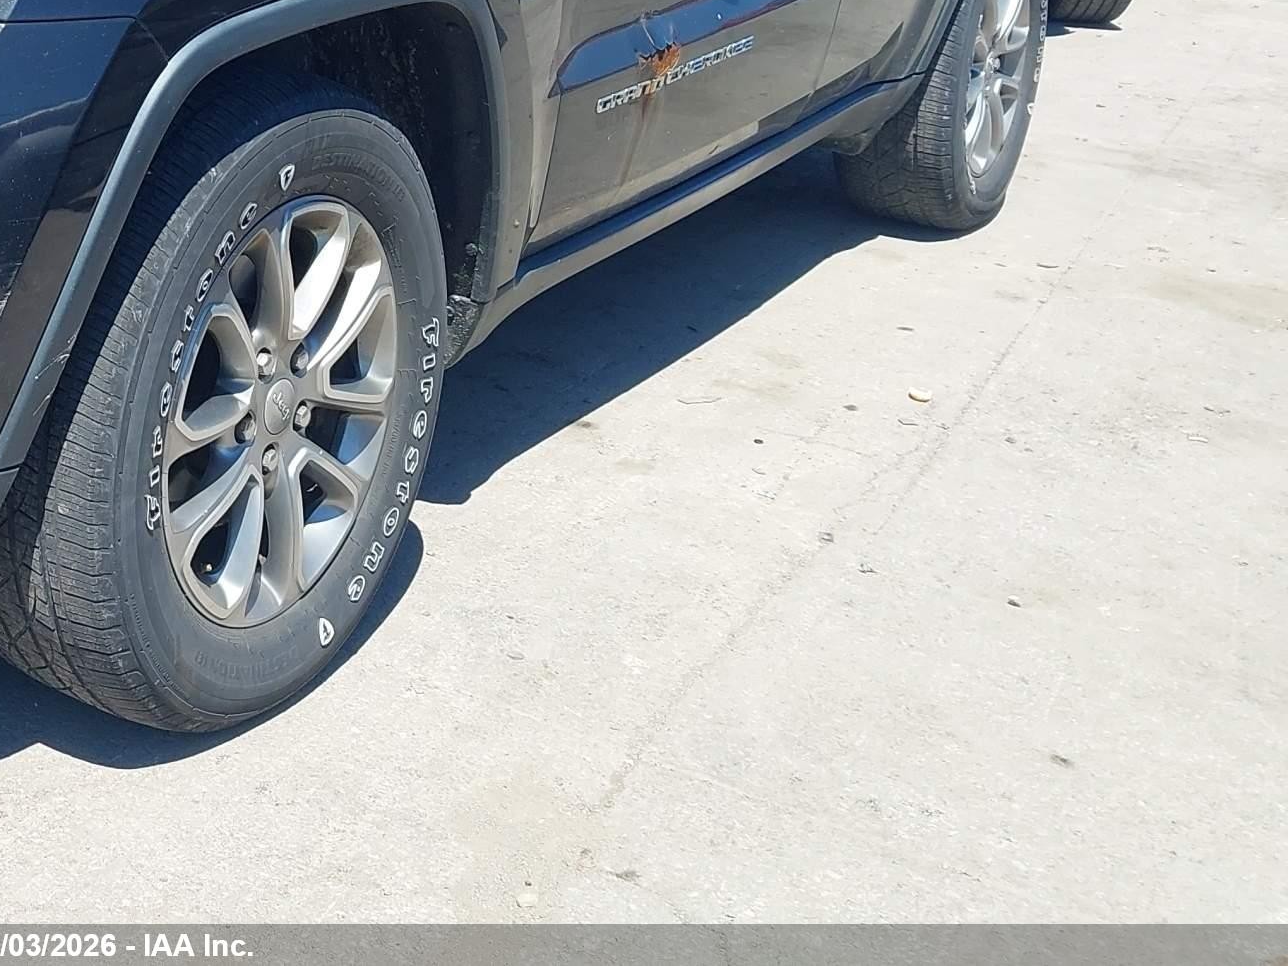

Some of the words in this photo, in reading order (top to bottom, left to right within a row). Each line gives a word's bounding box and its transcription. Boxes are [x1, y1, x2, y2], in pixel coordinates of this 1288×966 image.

[596, 76, 664, 114] GRAND
[665, 35, 755, 85] CHEROKEE
[146, 201, 258, 532] Firestone
[347, 318, 441, 603] Firestone
